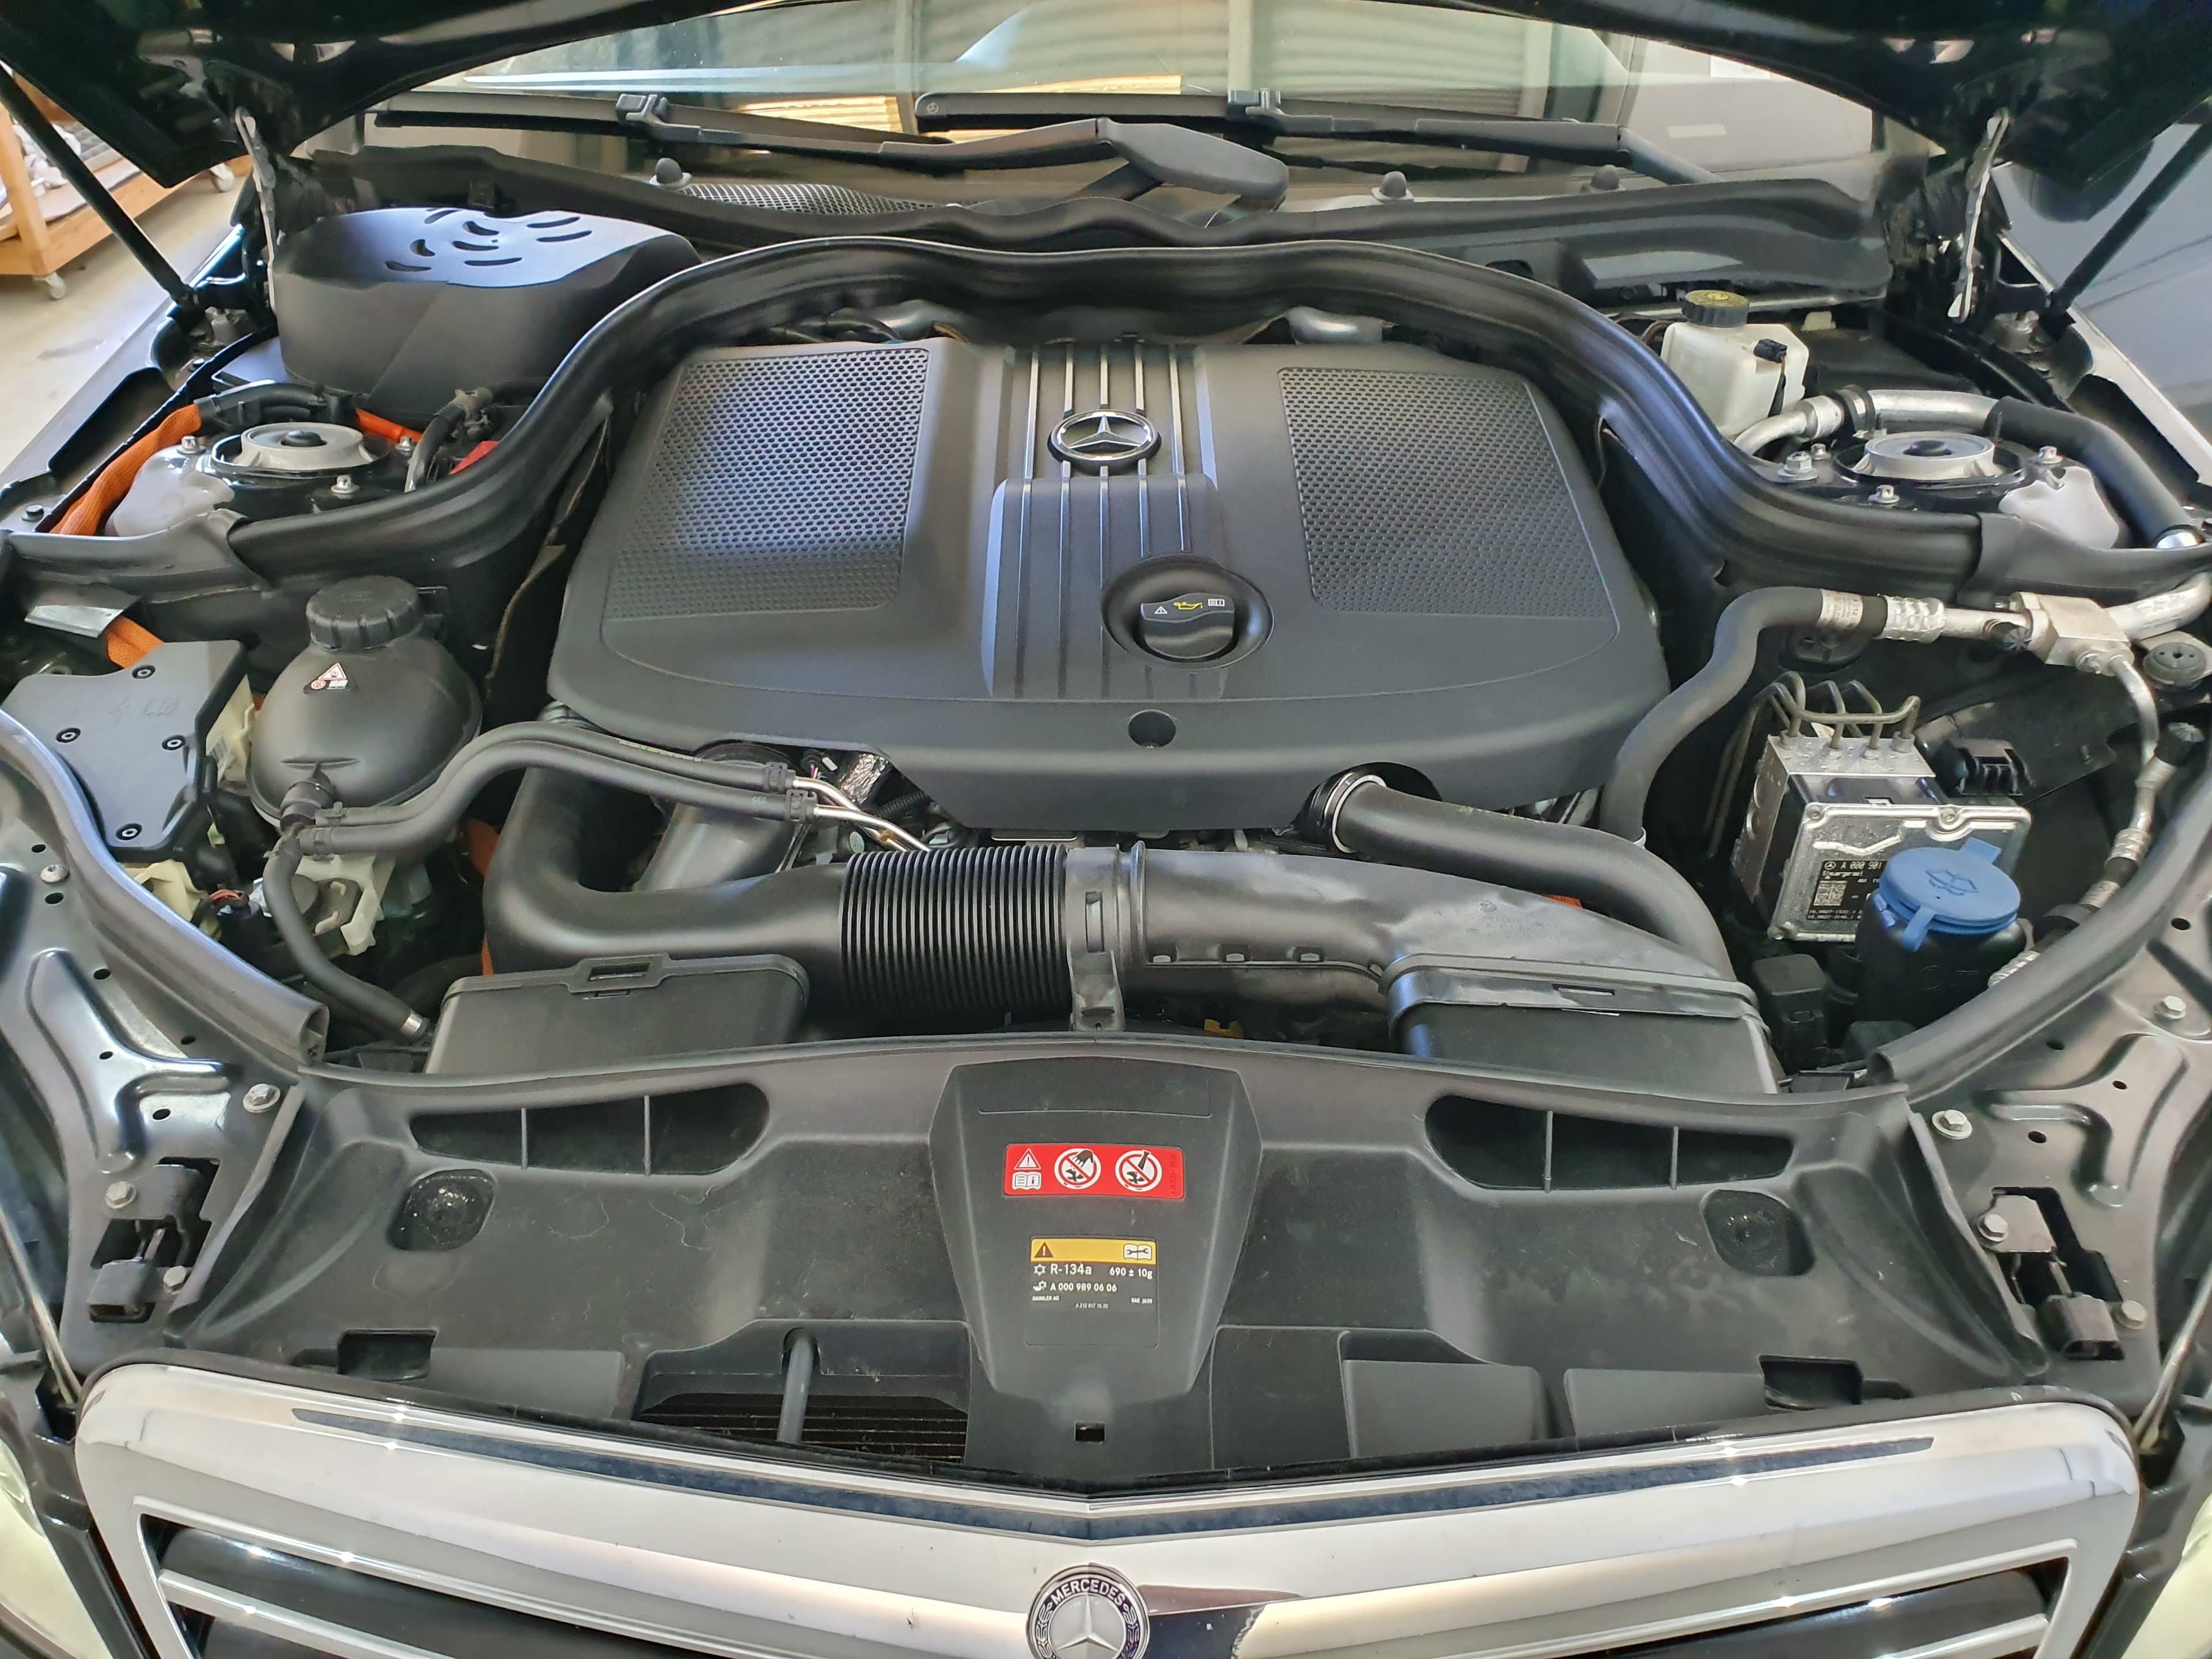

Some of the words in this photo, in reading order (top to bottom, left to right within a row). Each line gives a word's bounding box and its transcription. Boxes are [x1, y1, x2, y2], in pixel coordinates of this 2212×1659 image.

[1050, 1264, 1092, 1275] R-134a
[1109, 1267, 1127, 1276] 690
[1138, 1268, 1153, 1279] 10g
[1050, 1283, 1056, 1291] A
[1076, 1283, 1092, 1291] 989
[1094, 1283, 1104, 1291] 06
[1106, 1283, 1117, 1292] 06
[1050, 1579, 1126, 1605] MERCEDES
